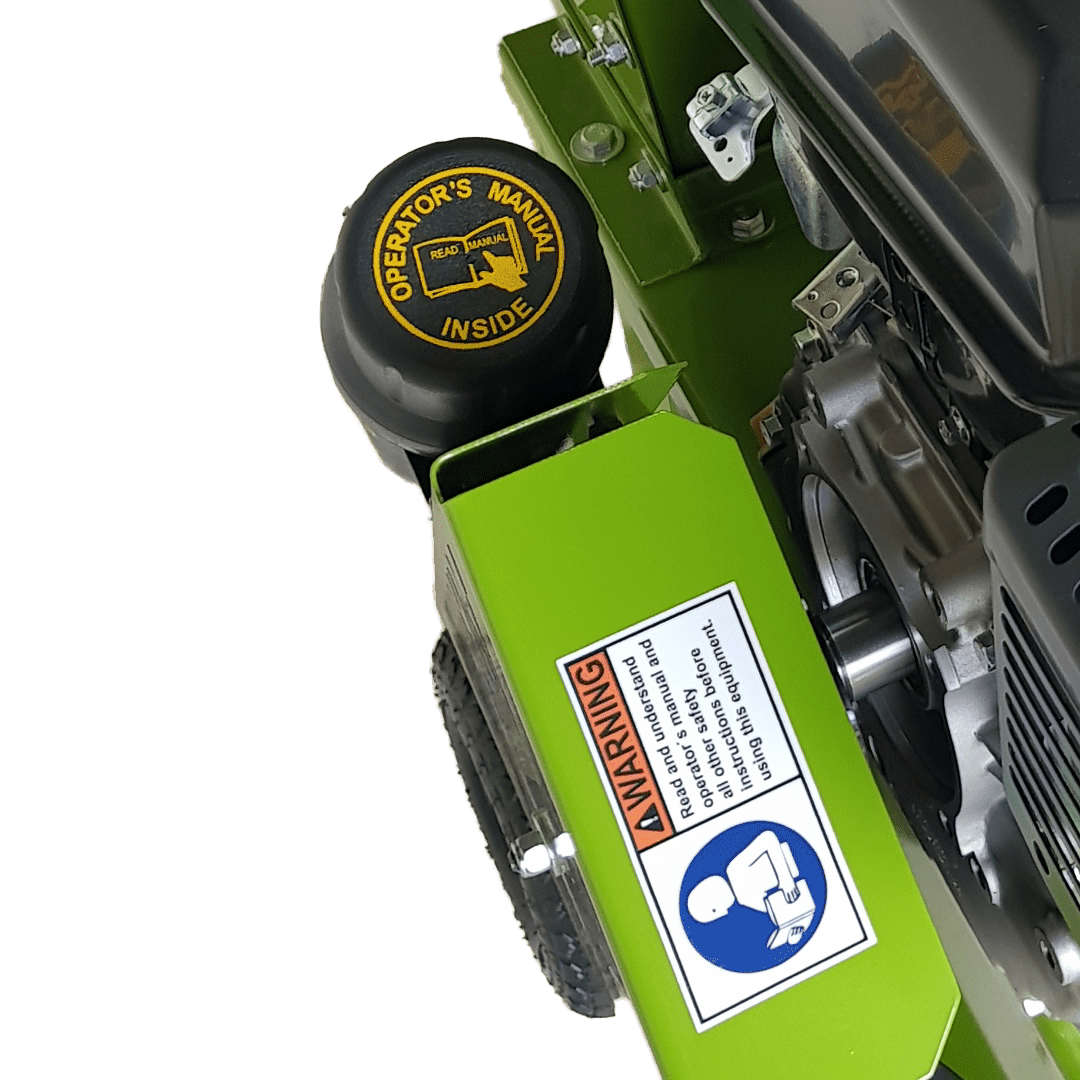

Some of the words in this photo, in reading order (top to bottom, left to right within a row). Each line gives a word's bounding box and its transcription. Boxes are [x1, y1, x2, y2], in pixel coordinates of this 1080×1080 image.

[486, 180, 555, 262] MANUAL
[429, 244, 459, 261] READ
[467, 232, 510, 251] MANUAL
[440, 296, 534, 341] INSIDE
[638, 638, 660, 667] and
[690, 647, 717, 699] before
[701, 618, 742, 703] equipment.
[621, 655, 666, 742] understand
[650, 669, 683, 727] manual
[683, 687, 708, 735] safety
[574, 658, 652, 812] WARNING
[735, 705, 755, 737] this
[656, 745, 678, 774] and
[701, 737, 726, 777] other
[710, 698, 754, 793] instructions
[748, 736, 773, 781] using
[668, 777, 695, 820] Read
[716, 779, 734, 800] all
